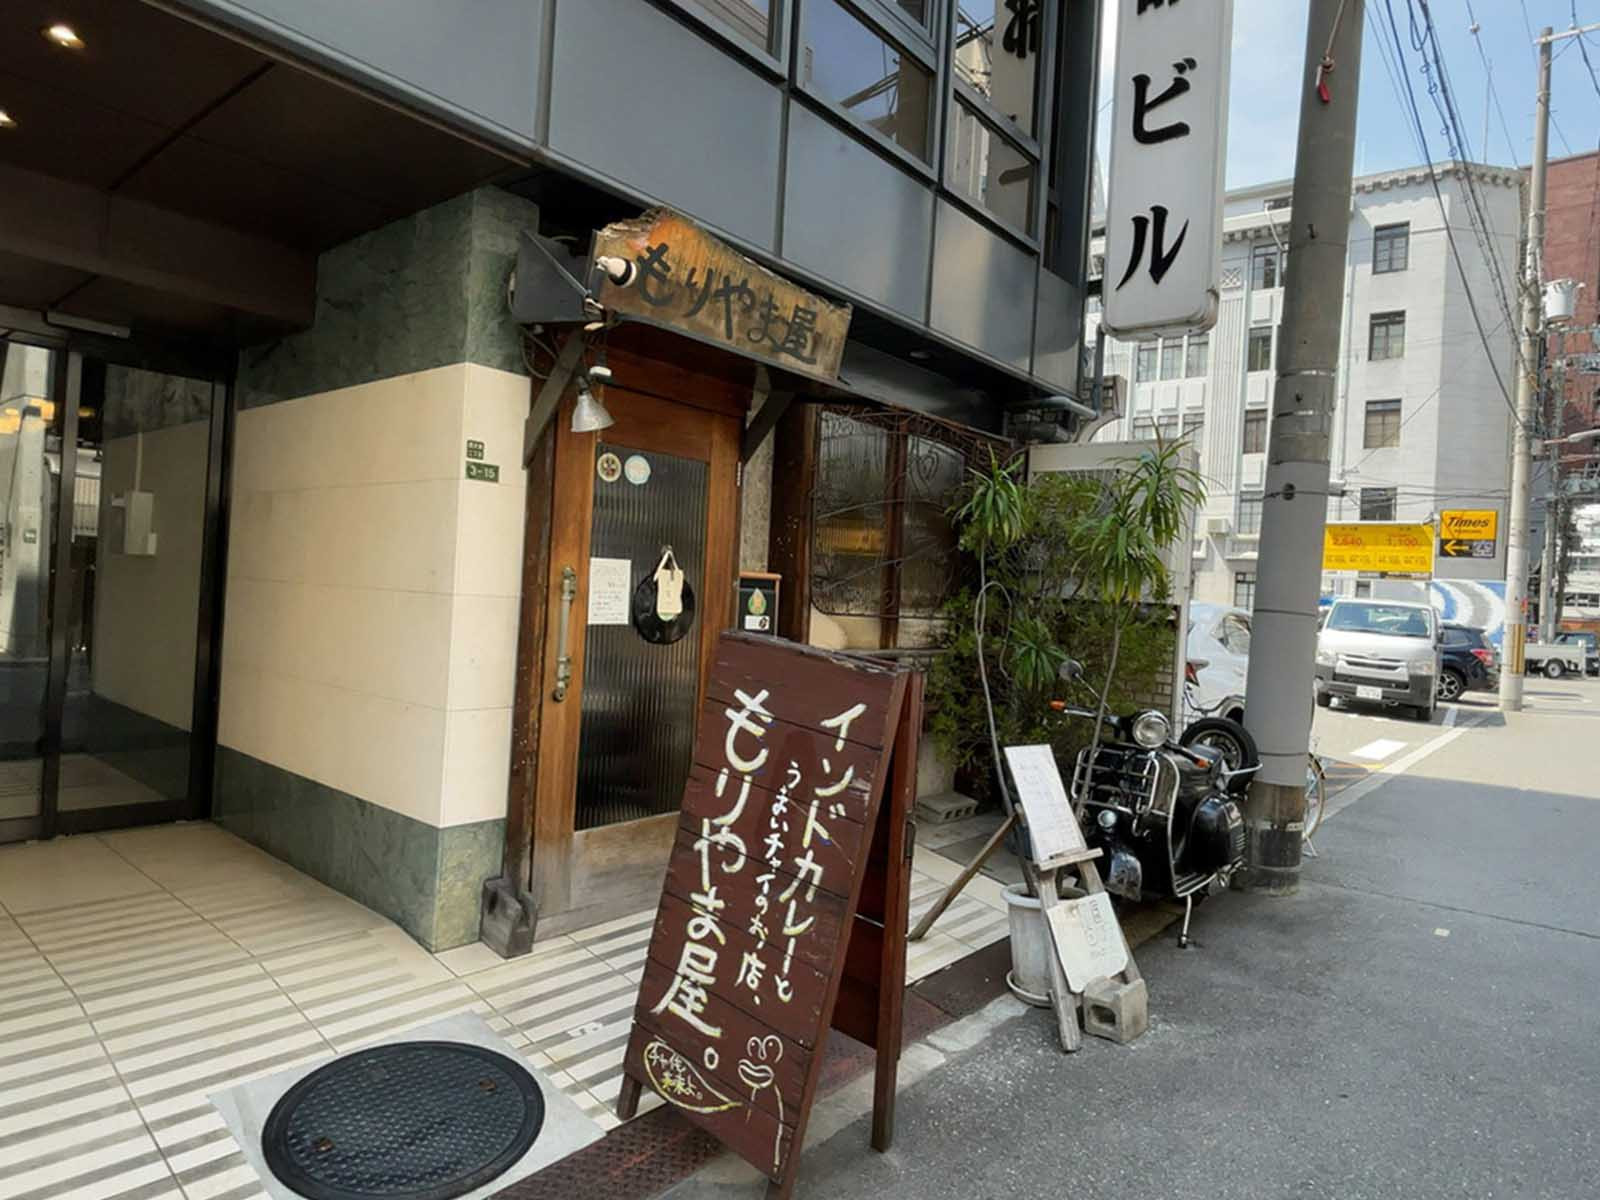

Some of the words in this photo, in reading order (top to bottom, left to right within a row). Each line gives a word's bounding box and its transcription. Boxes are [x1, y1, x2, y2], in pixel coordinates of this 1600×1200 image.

[1115, 0, 1197, 291] ビル
[636, 243, 820, 365] もりやま屋
[1448, 517, 1489, 528] Times
[774, 703, 867, 1002] インドカレーと
